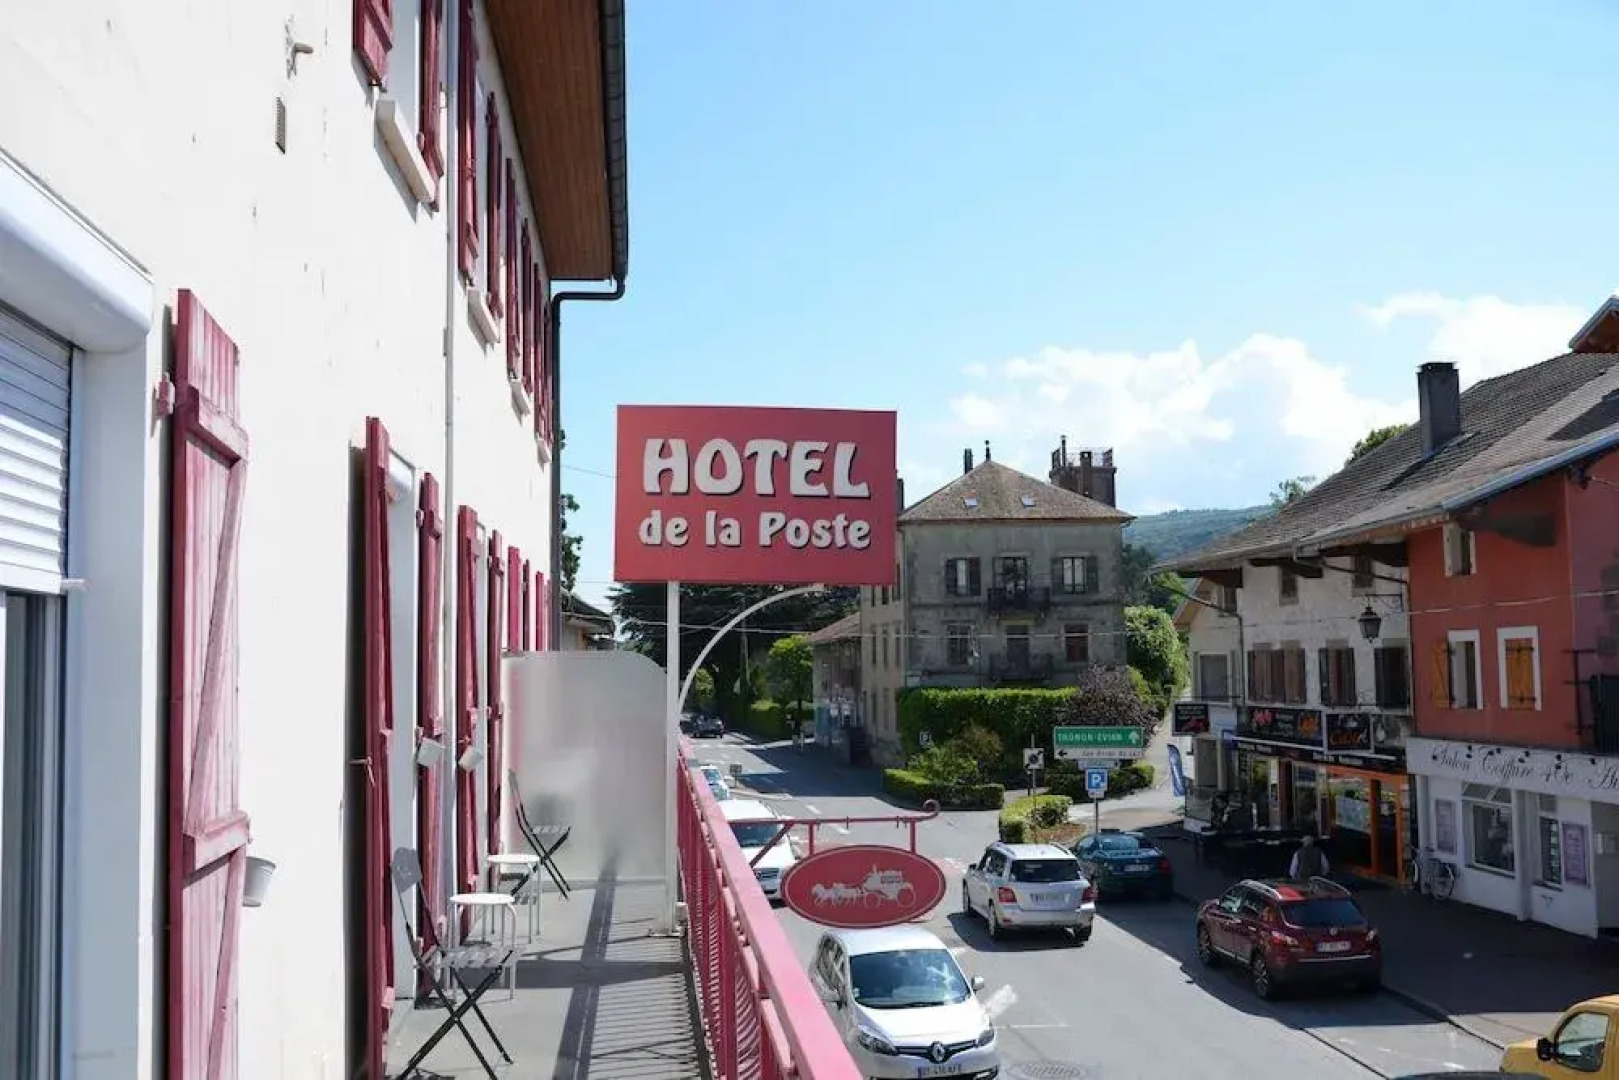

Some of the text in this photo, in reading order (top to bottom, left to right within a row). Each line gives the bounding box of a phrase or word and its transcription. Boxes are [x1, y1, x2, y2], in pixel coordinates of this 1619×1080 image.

[643, 438, 870, 498] HOTEL
[639, 509, 871, 549] de la Poste
[1092, 773, 1101, 785] P
